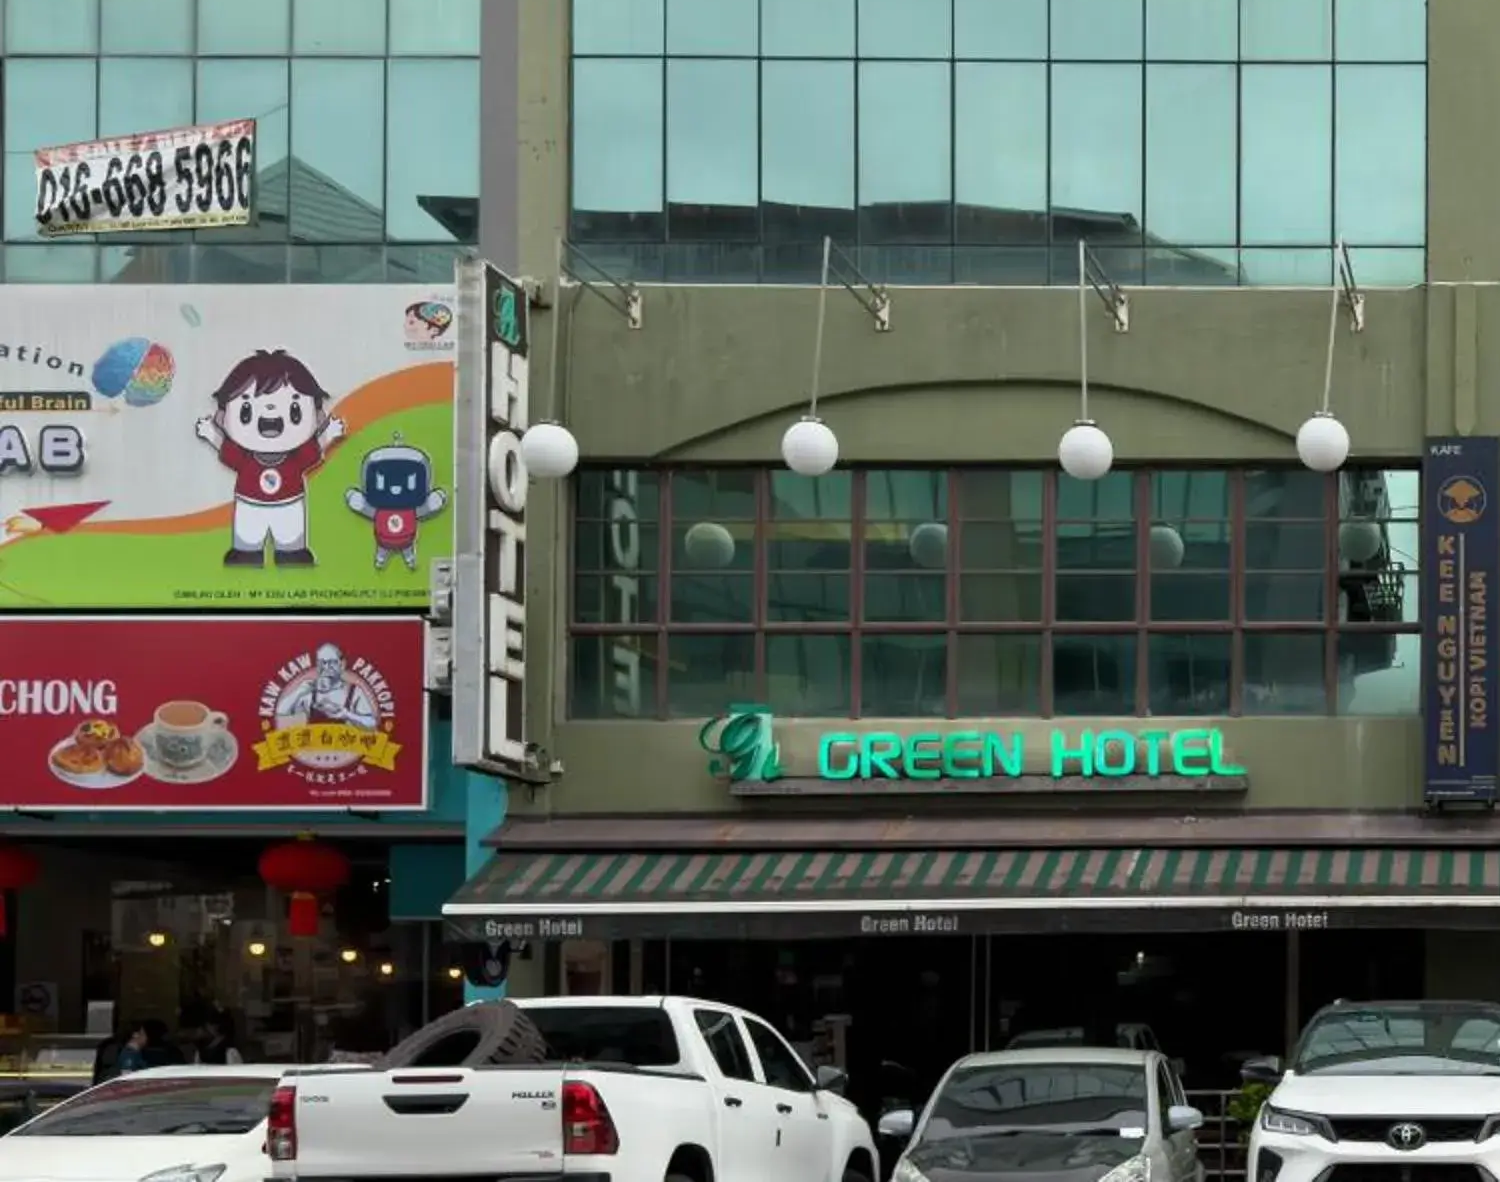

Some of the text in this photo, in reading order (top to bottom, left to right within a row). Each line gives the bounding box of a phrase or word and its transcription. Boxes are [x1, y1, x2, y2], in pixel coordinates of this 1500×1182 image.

[31, 394, 88, 410] Brain
[489, 341, 528, 761] HOTEL
[1469, 571, 1487, 728] KOPI VIETNAM
[0, 679, 118, 716] CHONG
[258, 681, 282, 717] KAW
[278, 653, 312, 682] KAW
[816, 727, 1248, 781] GREEN HOTEL
[485, 920, 583, 937] Green Hotel
[860, 915, 958, 932] Green Hotel
[1231, 912, 1328, 929] Green Hotel
